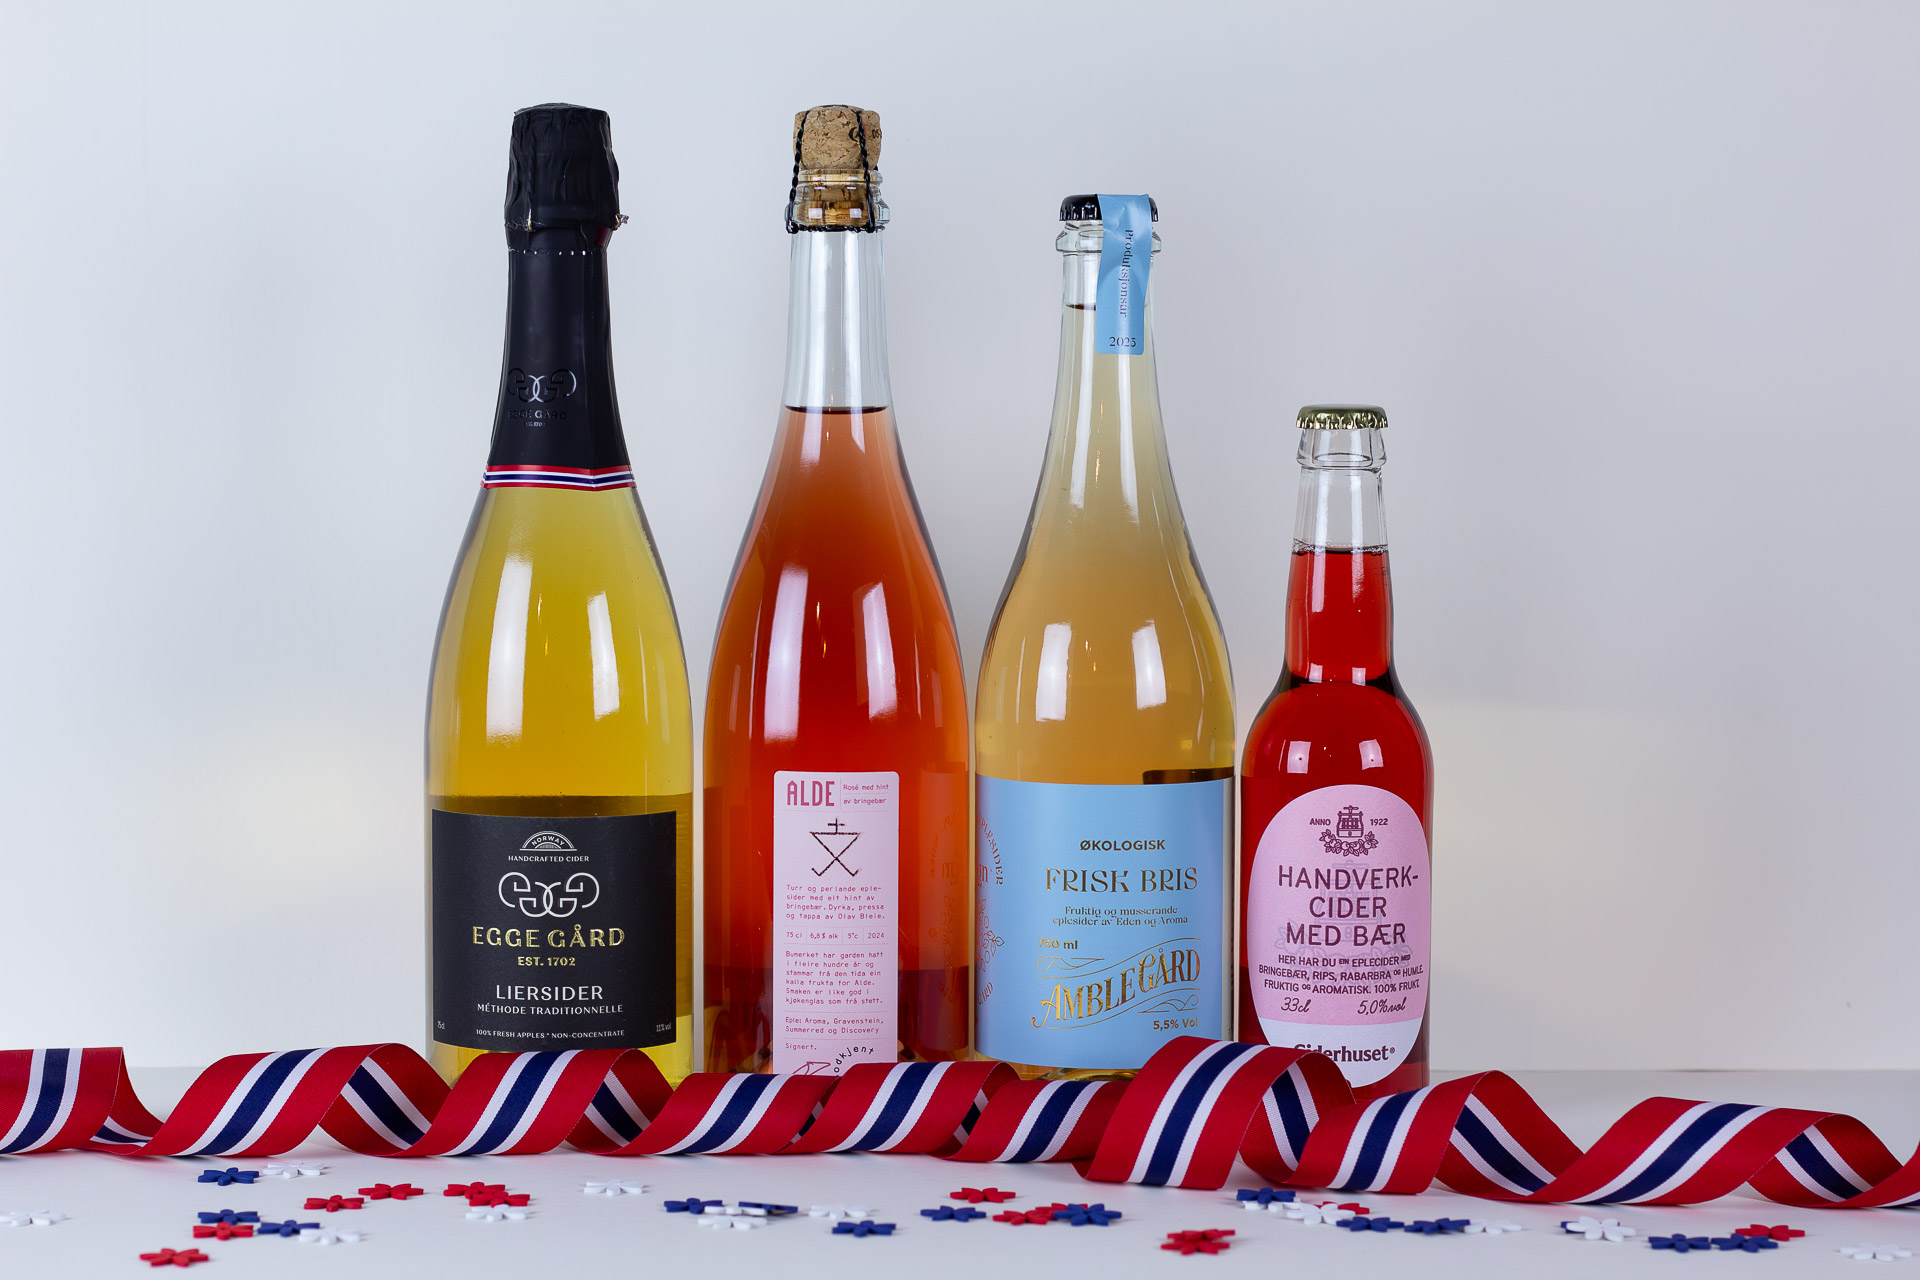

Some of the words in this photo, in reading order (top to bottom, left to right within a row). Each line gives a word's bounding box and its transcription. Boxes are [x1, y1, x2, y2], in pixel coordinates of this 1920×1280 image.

[1109, 336, 1136, 347] 2025
[843, 783, 859, 791] Rosé
[787, 780, 835, 806] ALDE
[1309, 818, 1331, 826] ANNO
[1369, 818, 1388, 826] 1922
[531, 835, 565, 846] NORWAY
[1080, 839, 1166, 851] ØKOLOGISK
[508, 855, 564, 863] HANDCRAFTED
[565, 855, 590, 863] CIDER
[1046, 867, 1129, 893] FRISK
[1140, 867, 1198, 893] BRIS
[1278, 864, 1418, 890] HANDVERK-
[820, 885, 856, 893] perlande
[786, 893, 806, 901] sider
[786, 903, 827, 911] bringebær.
[828, 904, 855, 912] Dyrka,
[1065, 905, 1102, 917] Fruktig
[1104, 909, 1117, 918] og
[1119, 906, 1178, 916] musserande
[1309, 896, 1387, 918] CIDER
[785, 912, 795, 920] og
[799, 912, 821, 920] tappa
[1052, 917, 1099, 926] eplesider
[1116, 917, 1141, 926] Eden
[1144, 919, 1157, 927] og
[1159, 916, 1189, 925] Aroma
[472, 926, 541, 948] EGGE
[547, 923, 626, 949] GÅRD
[867, 931, 885, 939] 2024
[1286, 922, 1341, 946] MED
[1353, 922, 1406, 946] BÆR
[1037, 937, 1060, 949] 750
[1063, 939, 1078, 950] ml
[785, 950, 819, 958] Bumerket
[840, 951, 865, 960] garden
[1279, 954, 1296, 964] HER
[1298, 956, 1320, 967] HAR
[1321, 957, 1337, 967] DU
[1351, 955, 1400, 967] EPLECIDER
[517, 956, 544, 967] EST.
[547, 956, 576, 967] 1702
[1258, 964, 1310, 981] BRINGEBÆR,
[1312, 971, 1340, 983] RIPS,
[1340, 970, 1392, 981] RABARBRA
[1393, 968, 1402, 976] OG
[496, 984, 604, 1001] LIERSIDER
[785, 987, 812, 995] Smaken
[848, 988, 863, 997] god
[1031, 966, 1136, 1029] AMBLE
[1138, 947, 1201, 993] GÅRD
[1264, 979, 1300, 992] FRUKTIG
[1301, 983, 1312, 991] OG
[1311, 984, 1372, 995] AROMATISK.
[1374, 983, 1397, 993] 100%
[785, 996, 825, 1006] kjøkenglas
[1280, 996, 1312, 1013] 33cl
[477, 1002, 527, 1015] MÉTHODE
[529, 1004, 624, 1015] TRADITIONNELLE
[785, 1016, 803, 1025] Eple:
[804, 1017, 830, 1025] Aroma,
[833, 1017, 884, 1025] Gravenstein,
[1153, 1019, 1179, 1032] 5,5%
[1181, 1016, 1198, 1028] Vol
[492, 1030, 516, 1038] FRESH
[516, 1031, 545, 1039] APPLES
[551, 1029, 625, 1039] NON-CONCENTRATE
[785, 1025, 824, 1034] Summerred
[785, 1042, 817, 1051] Signert.
[833, 1046, 875, 1076] odkjent
